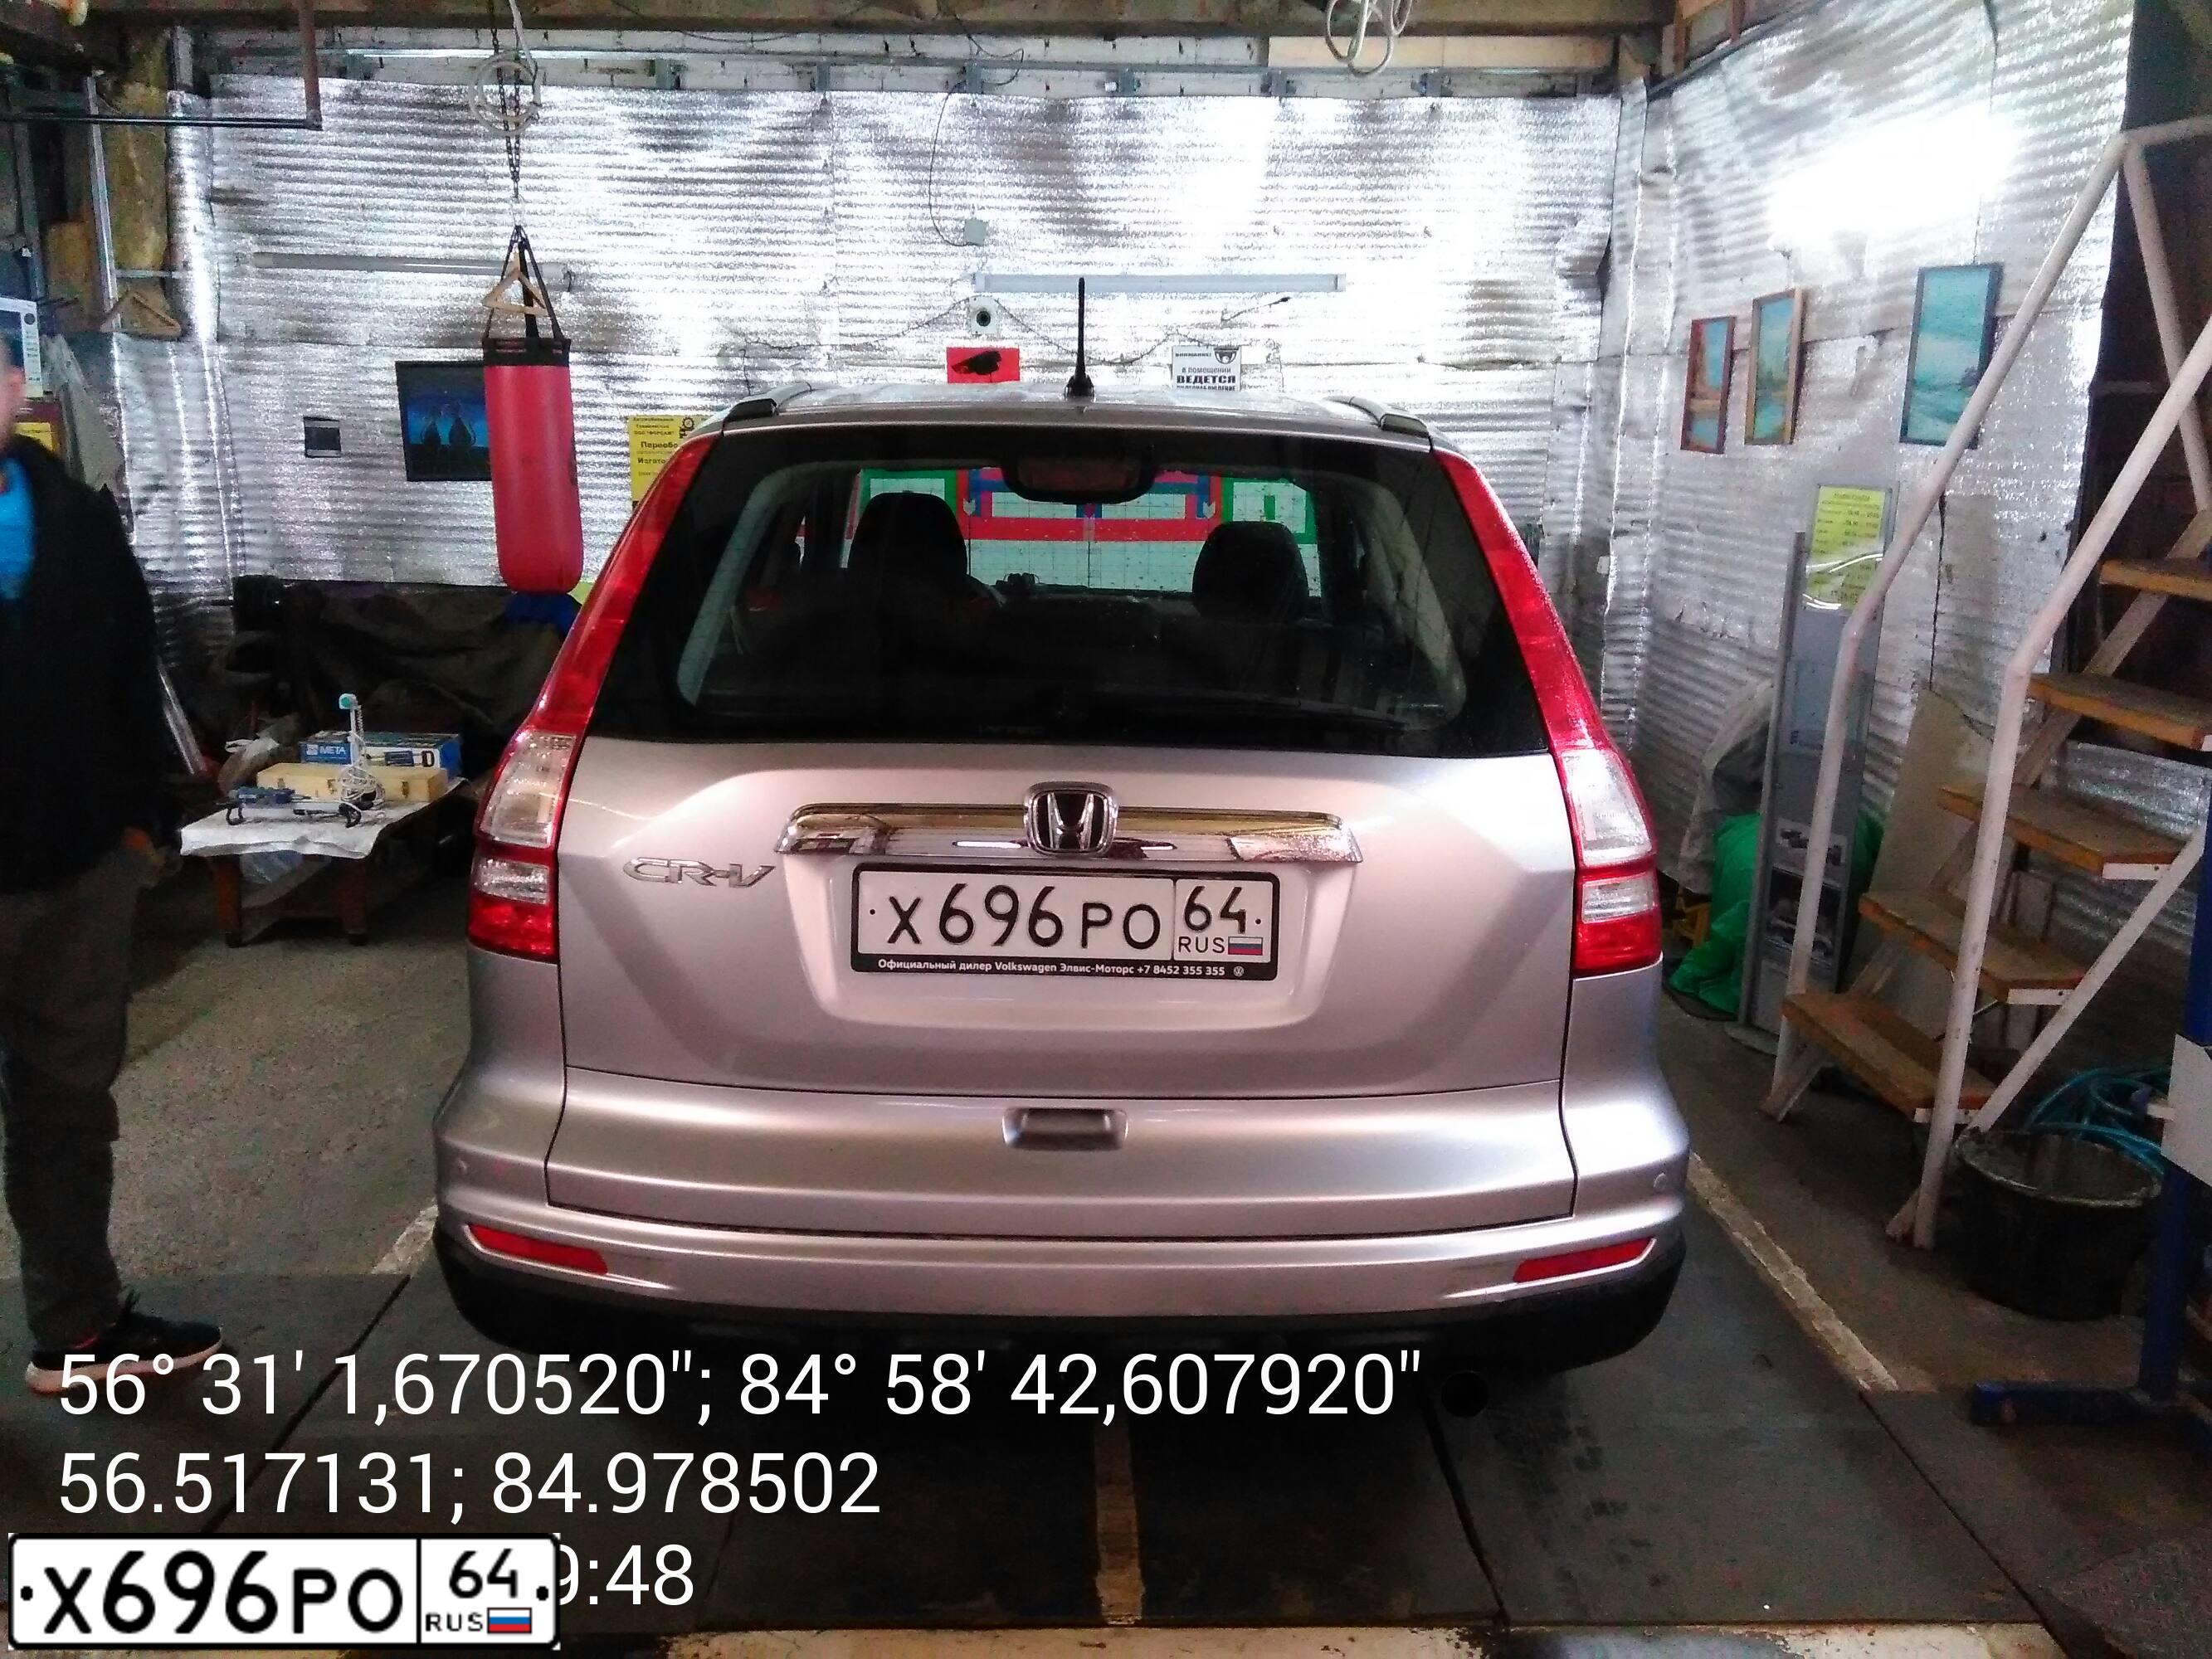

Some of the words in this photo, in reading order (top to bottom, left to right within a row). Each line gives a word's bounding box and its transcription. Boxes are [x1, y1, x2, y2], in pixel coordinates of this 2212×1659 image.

[1177, 375, 1236, 384] ВЕДЕТСЯ
[623, 857, 776, 888] CR-V
[887, 883, 1162, 950] Х696РО
[1185, 884, 1246, 934] 64
[1177, 936, 1225, 954] RUS
[878, 959, 957, 971] Официальный
[958, 962, 992, 972] дилер
[995, 961, 1057, 973] Volkswagen
[1059, 963, 1135, 975] Элвис-Моторс
[1137, 965, 1151, 974] +7
[1152, 965, 1180, 975] 8452
[1182, 966, 1202, 975] 355
[1205, 966, 1225, 975] 355
